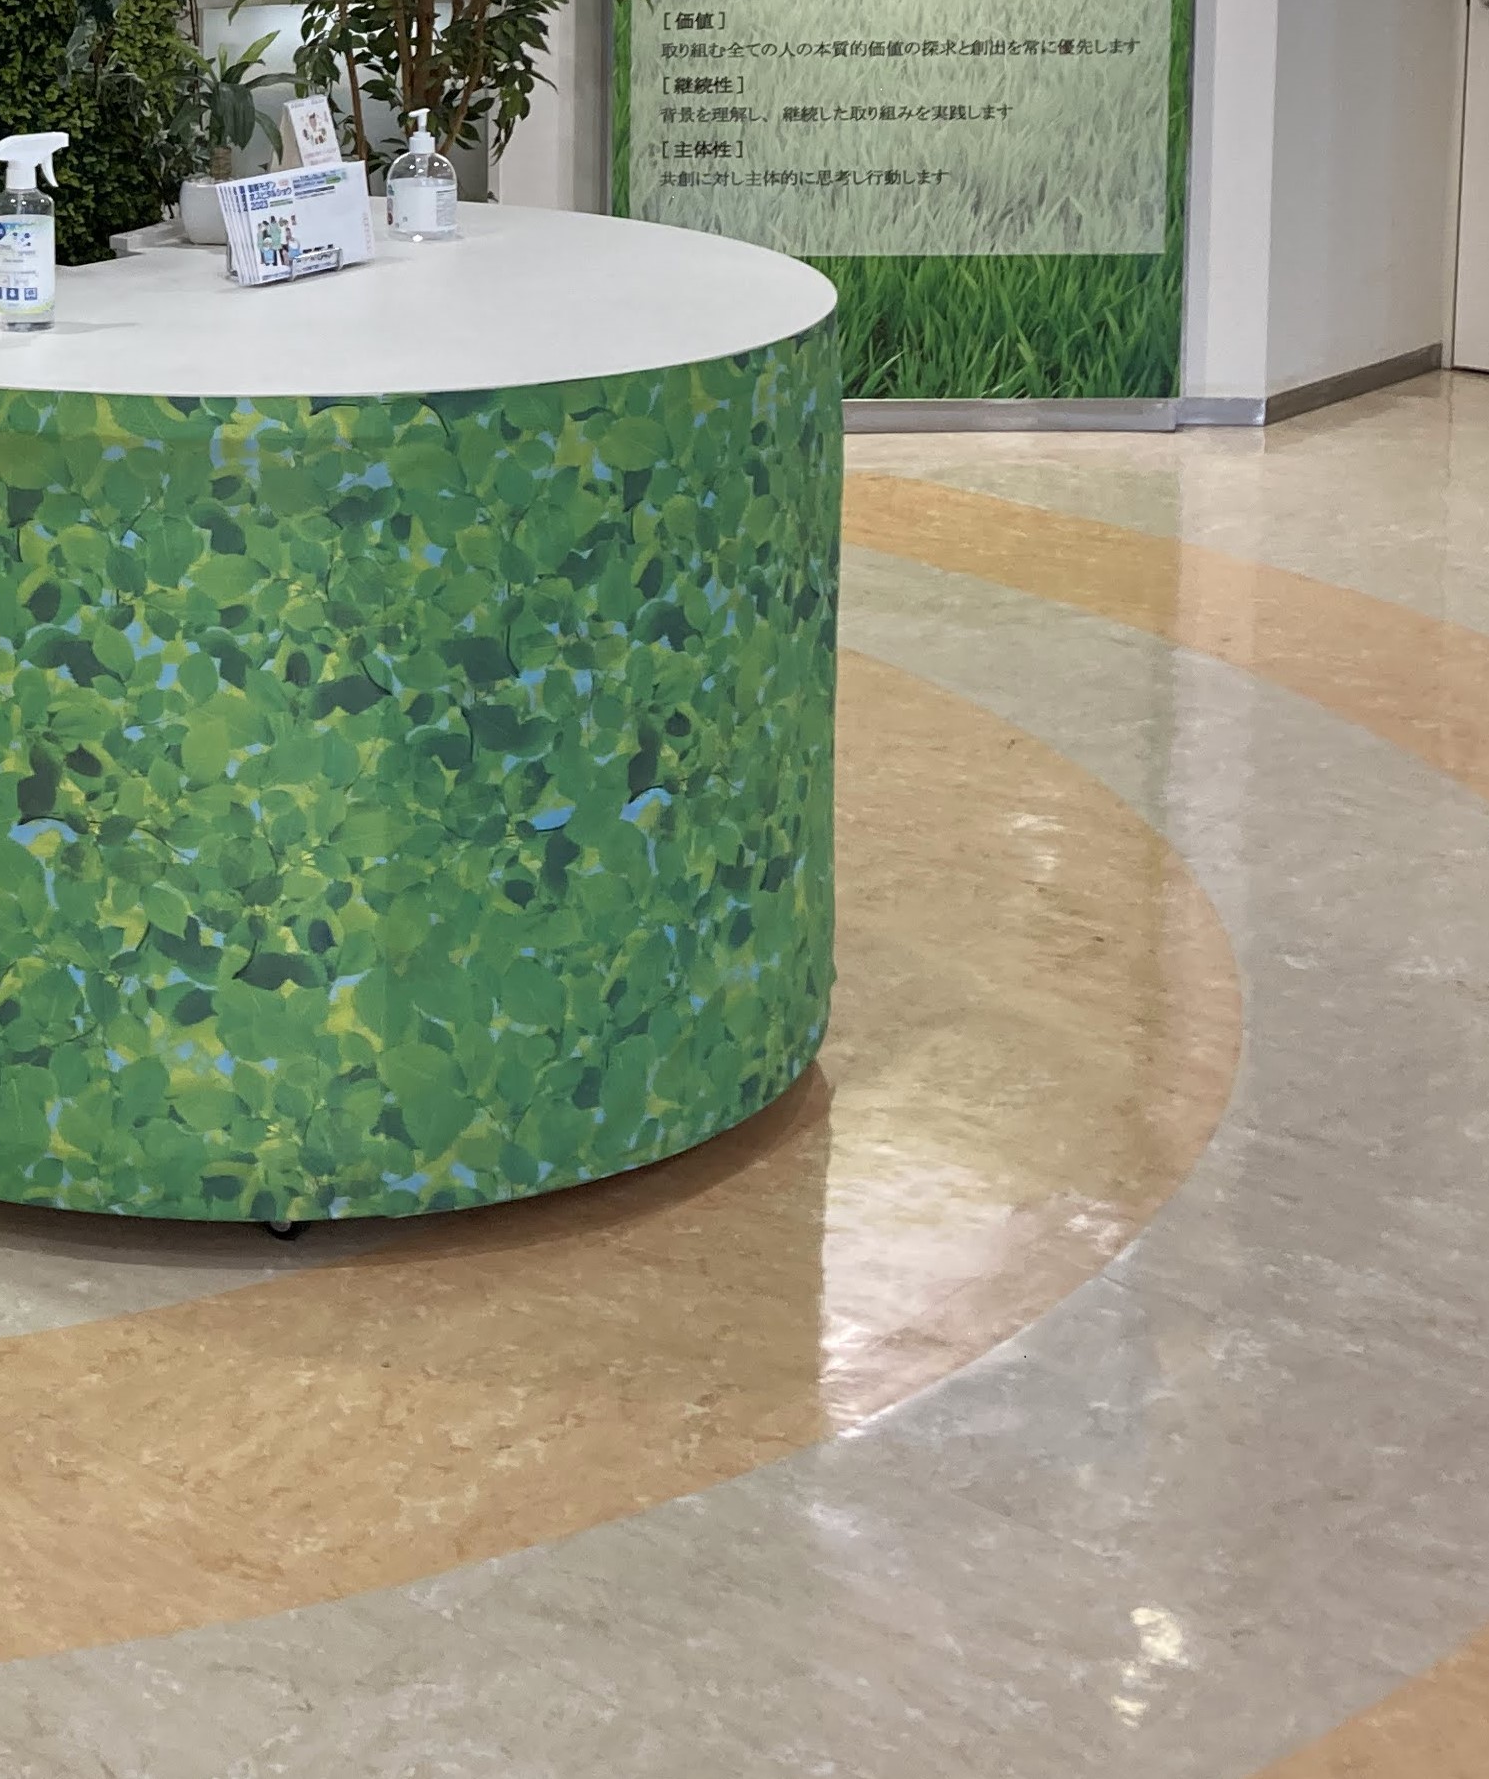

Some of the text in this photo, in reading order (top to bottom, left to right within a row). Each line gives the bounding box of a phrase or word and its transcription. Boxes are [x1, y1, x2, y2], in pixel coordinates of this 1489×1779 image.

[659, 169, 950, 188] 共創に対し主体的に思考し行動します
